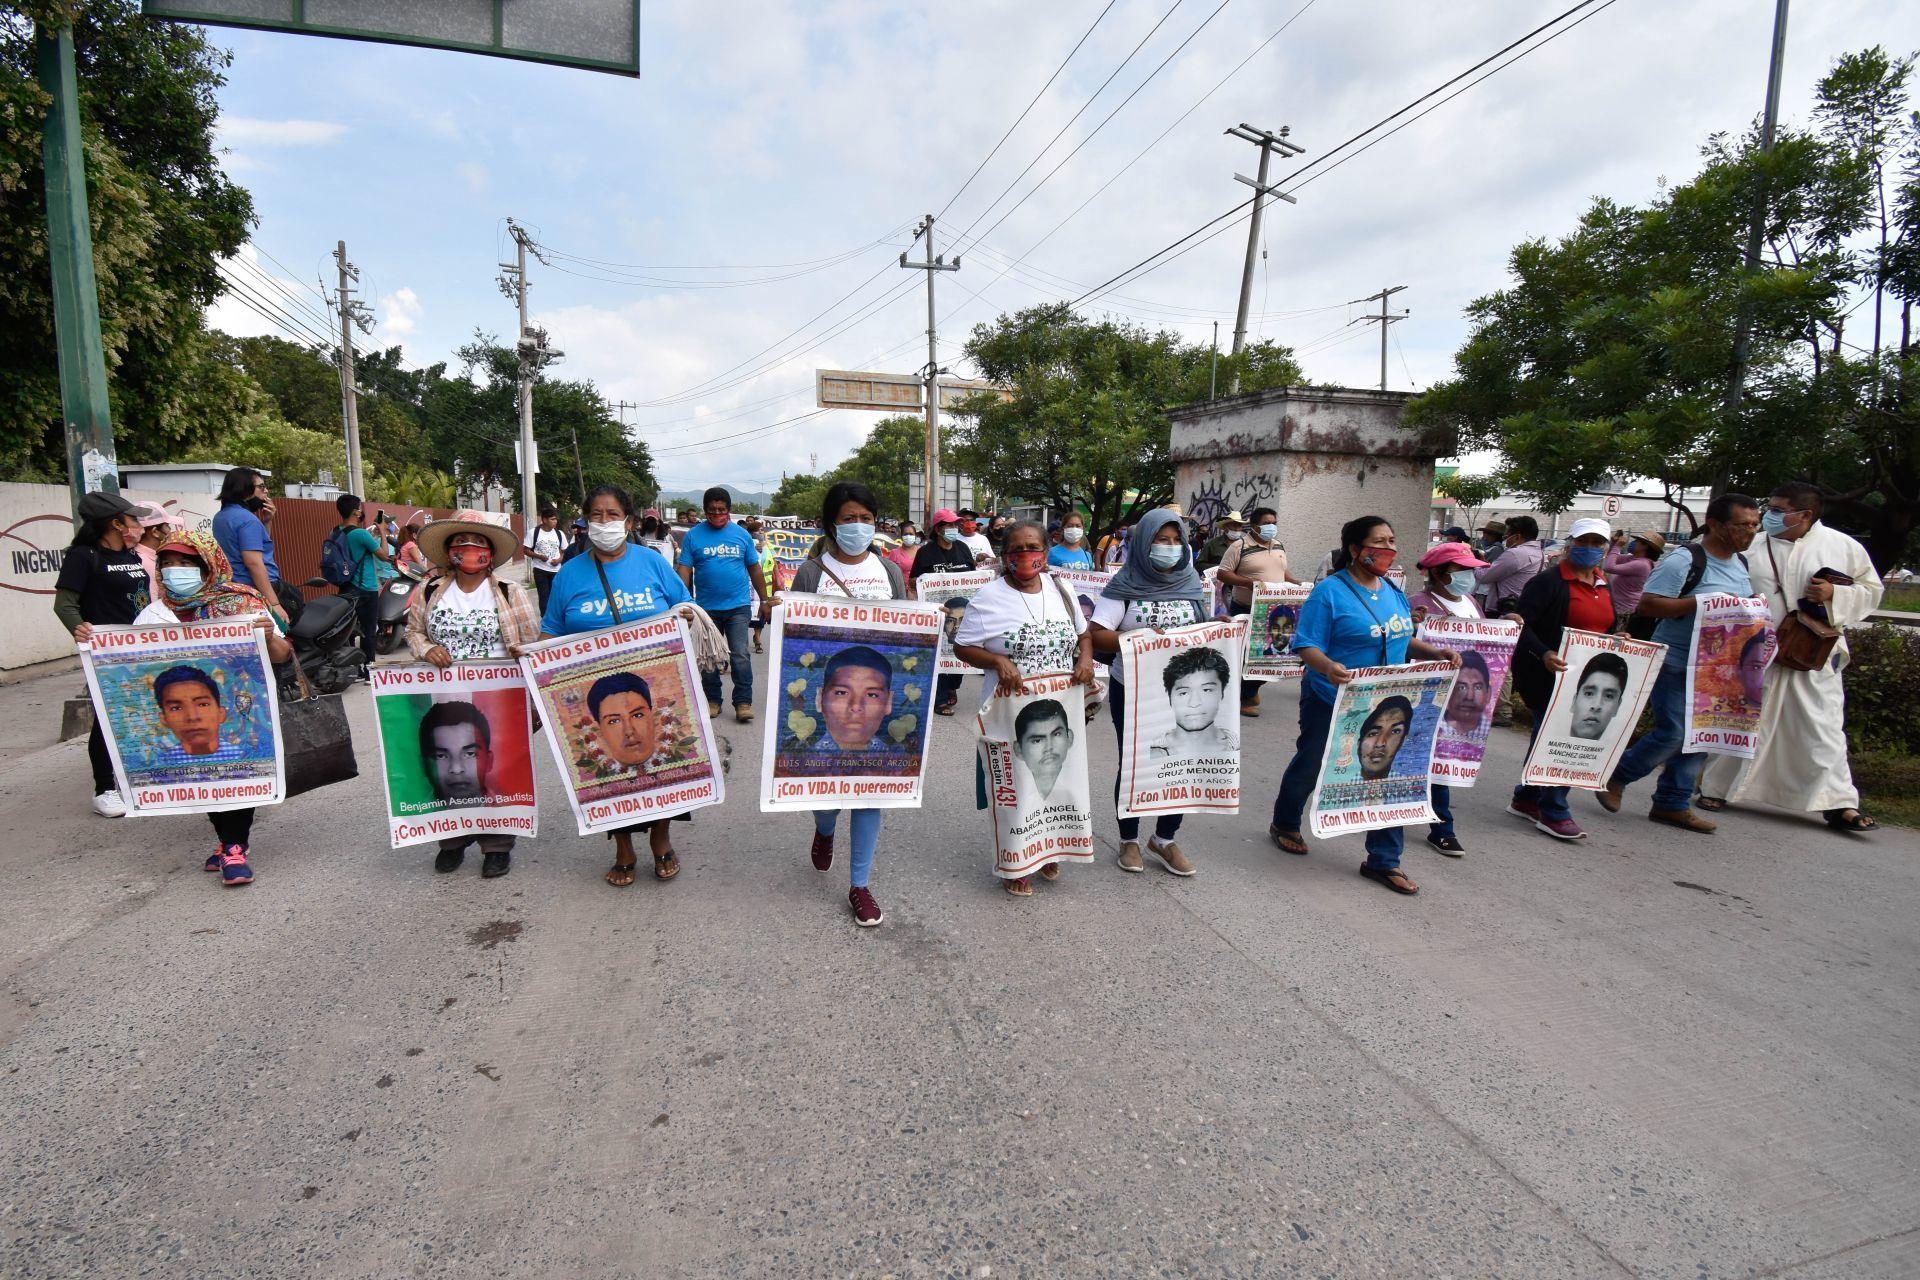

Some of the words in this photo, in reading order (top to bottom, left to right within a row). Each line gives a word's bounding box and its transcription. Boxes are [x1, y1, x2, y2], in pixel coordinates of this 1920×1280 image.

[127, 570, 146, 578] VIVE
[1081, 573, 1087, 581] lo
[922, 581, 941, 590] ¡Vivo
[961, 577, 991, 585] llevaron!
[1706, 597, 1740, 611] ¡Vivo
[787, 601, 828, 618] ¡Vivo
[832, 607, 849, 620] se
[853, 606, 868, 622] lo
[872, 608, 938, 627] llevaron!
[1424, 619, 1450, 632] ¡Vivo
[1452, 622, 1463, 632] se
[1465, 622, 1475, 634] lo
[91, 633, 136, 650] ¡Vivo
[142, 631, 159, 643] se
[163, 628, 179, 642] lo
[182, 623, 251, 641] llevaron!
[530, 645, 572, 669] ¡Vivo
[574, 641, 593, 655] se
[594, 636, 610, 650] lo
[611, 619, 677, 645] llevaron!
[1137, 637, 1171, 655] ¡Vivo
[1175, 638, 1188, 648] se
[1189, 634, 1202, 646] lo
[1571, 634, 1596, 647] ¡Vivo
[1597, 639, 1606, 649] se
[1607, 639, 1616, 651] lo
[1618, 641, 1654, 658] llevaron!
[373, 670, 413, 689] ¡Vivo
[417, 671, 435, 683] se
[439, 667, 453, 682] lo
[458, 666, 524, 681] llevaron!
[1015, 685, 1030, 697] se
[1033, 681, 1047, 695] lo
[1694, 732, 1719, 744] ¡Con
[1723, 732, 1749, 748] VIDA
[175, 768, 195, 776] LUIS
[200, 766, 219, 775] LUNA
[224, 764, 254, 773] TORRES
[778, 759, 800, 768] LUIS
[804, 759, 831, 767] ANGEL
[837, 759, 882, 767] FRANCISCO
[886, 759, 918, 767] ARZOLA
[1002, 750, 1013, 786] faltan
[1161, 758, 1194, 771] JORGE
[1431, 763, 1450, 776] IDA
[1452, 764, 1459, 777] lo
[1157, 769, 1184, 779] CRUZ
[1186, 767, 1240, 775] MENDOZA
[1165, 778, 1189, 786] EDAD
[1529, 764, 1544, 777] ¡Con
[1545, 766, 1562, 778] VIDA
[1563, 769, 1570, 779] lo
[1569, 770, 1601, 782] queremos!
[138, 791, 164, 806] ¡Con
[166, 787, 195, 802] VIDA
[198, 786, 209, 800] lo
[211, 782, 272, 801] queremos!
[777, 782, 804, 799] ¡Con
[807, 781, 836, 795] VIDA
[839, 780, 851, 794] lo
[853, 780, 913, 796] queremos!
[995, 785, 1018, 810] 43!
[1136, 791, 1159, 805] ¡Con
[1162, 786, 1188, 800] VIDA
[1191, 785, 1202, 799] lo
[449, 796, 493, 806] Ascencio
[495, 793, 534, 804] Bautista
[587, 806, 612, 823] ¡Con
[613, 800, 641, 814] VIDA
[642, 796, 653, 808] lo
[656, 782, 712, 808] queremos!
[1025, 809, 1041, 823] LUIS
[1042, 804, 1078, 815] ÁNGEL
[1320, 813, 1341, 829] ¡Con
[1343, 810, 1367, 825] VIDA
[1367, 810, 1377, 822] lo
[1378, 805, 1427, 823] queremos!
[394, 824, 426, 842] ¡Con
[427, 818, 458, 834] Vida
[460, 816, 473, 829] lo
[476, 815, 534, 831] queremos!
[1009, 819, 1044, 835] ABARCA
[1001, 849, 1019, 864] ¡Con
[1022, 840, 1043, 860] VIDA
[1044, 837, 1054, 850] lo
